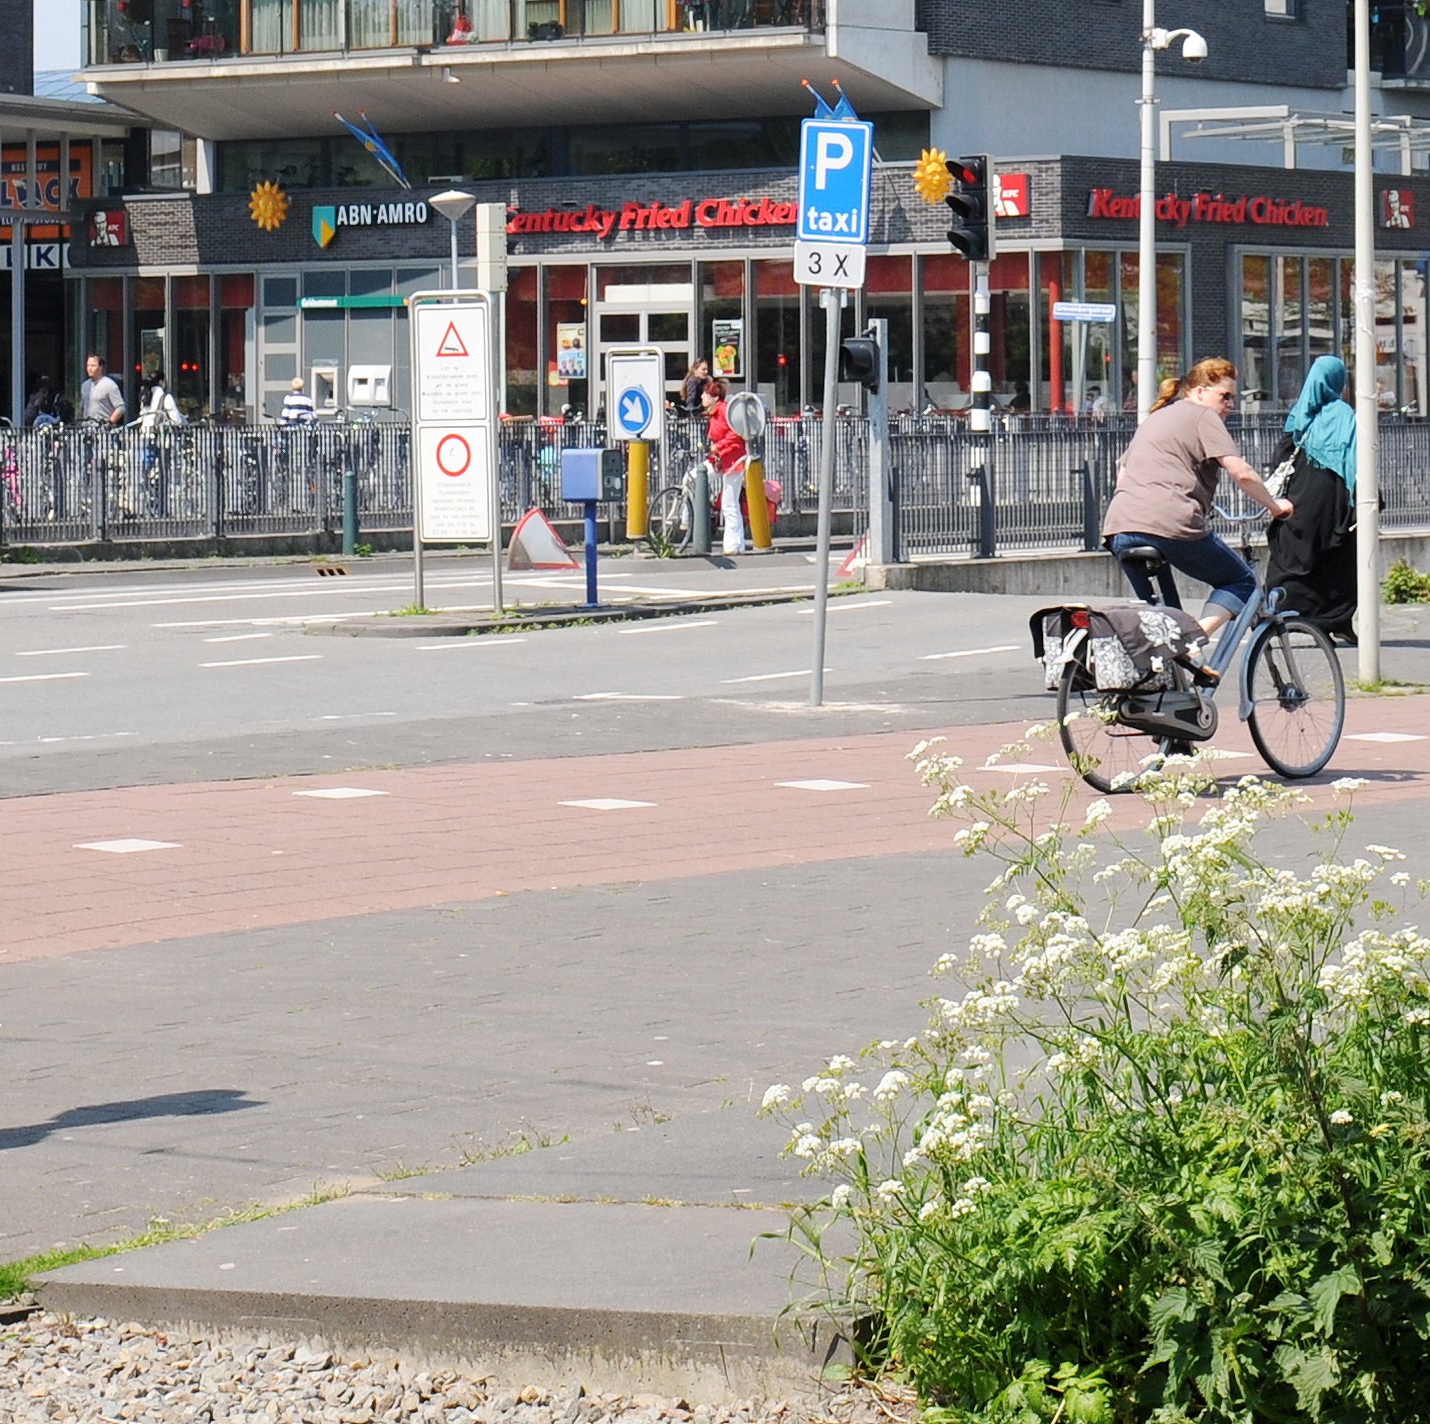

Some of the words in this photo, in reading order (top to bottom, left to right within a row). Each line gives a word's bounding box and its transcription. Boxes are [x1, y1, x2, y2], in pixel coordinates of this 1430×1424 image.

[815, 131, 854, 190] P
[1002, 188, 1020, 199] KFC
[1087, 188, 1190, 229] Kentcky
[1192, 192, 1248, 223] Fried
[1251, 195, 1328, 226] Chicken
[619, 197, 692, 231] Fried
[807, 205, 858, 233] taxi
[807, 252, 822, 275] 3
